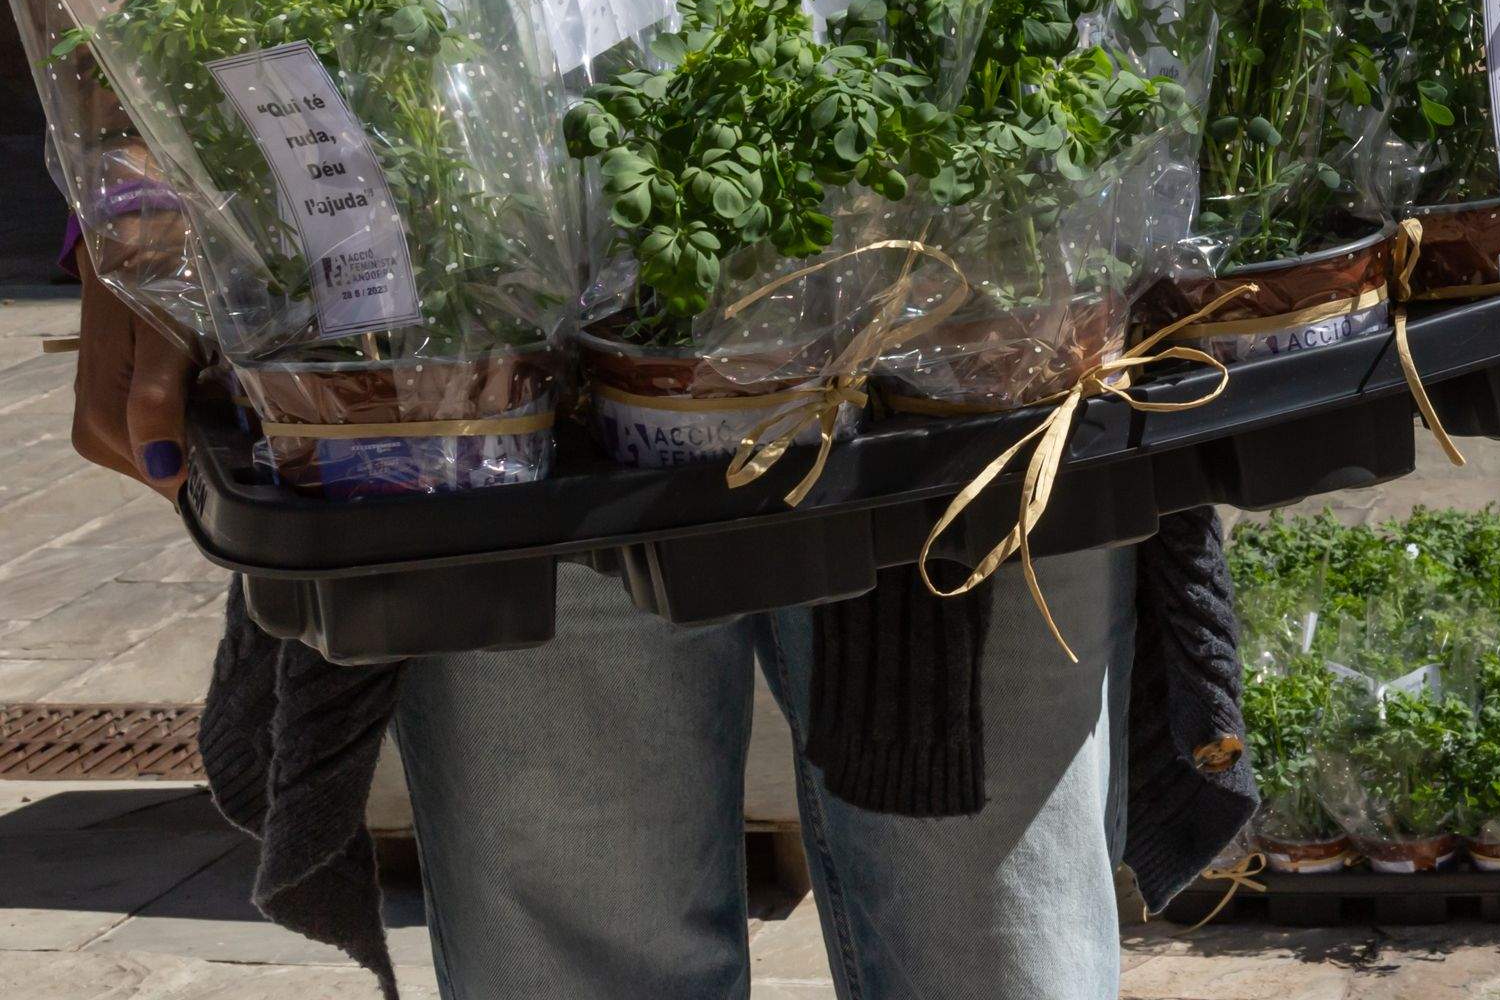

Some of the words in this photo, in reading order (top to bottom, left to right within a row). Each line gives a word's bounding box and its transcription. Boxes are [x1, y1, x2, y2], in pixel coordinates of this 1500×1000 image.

[303, 93, 326, 111] té
[286, 128, 337, 149] ruda,
[306, 160, 346, 180] Déu
[654, 420, 732, 447] ACCIÓ
